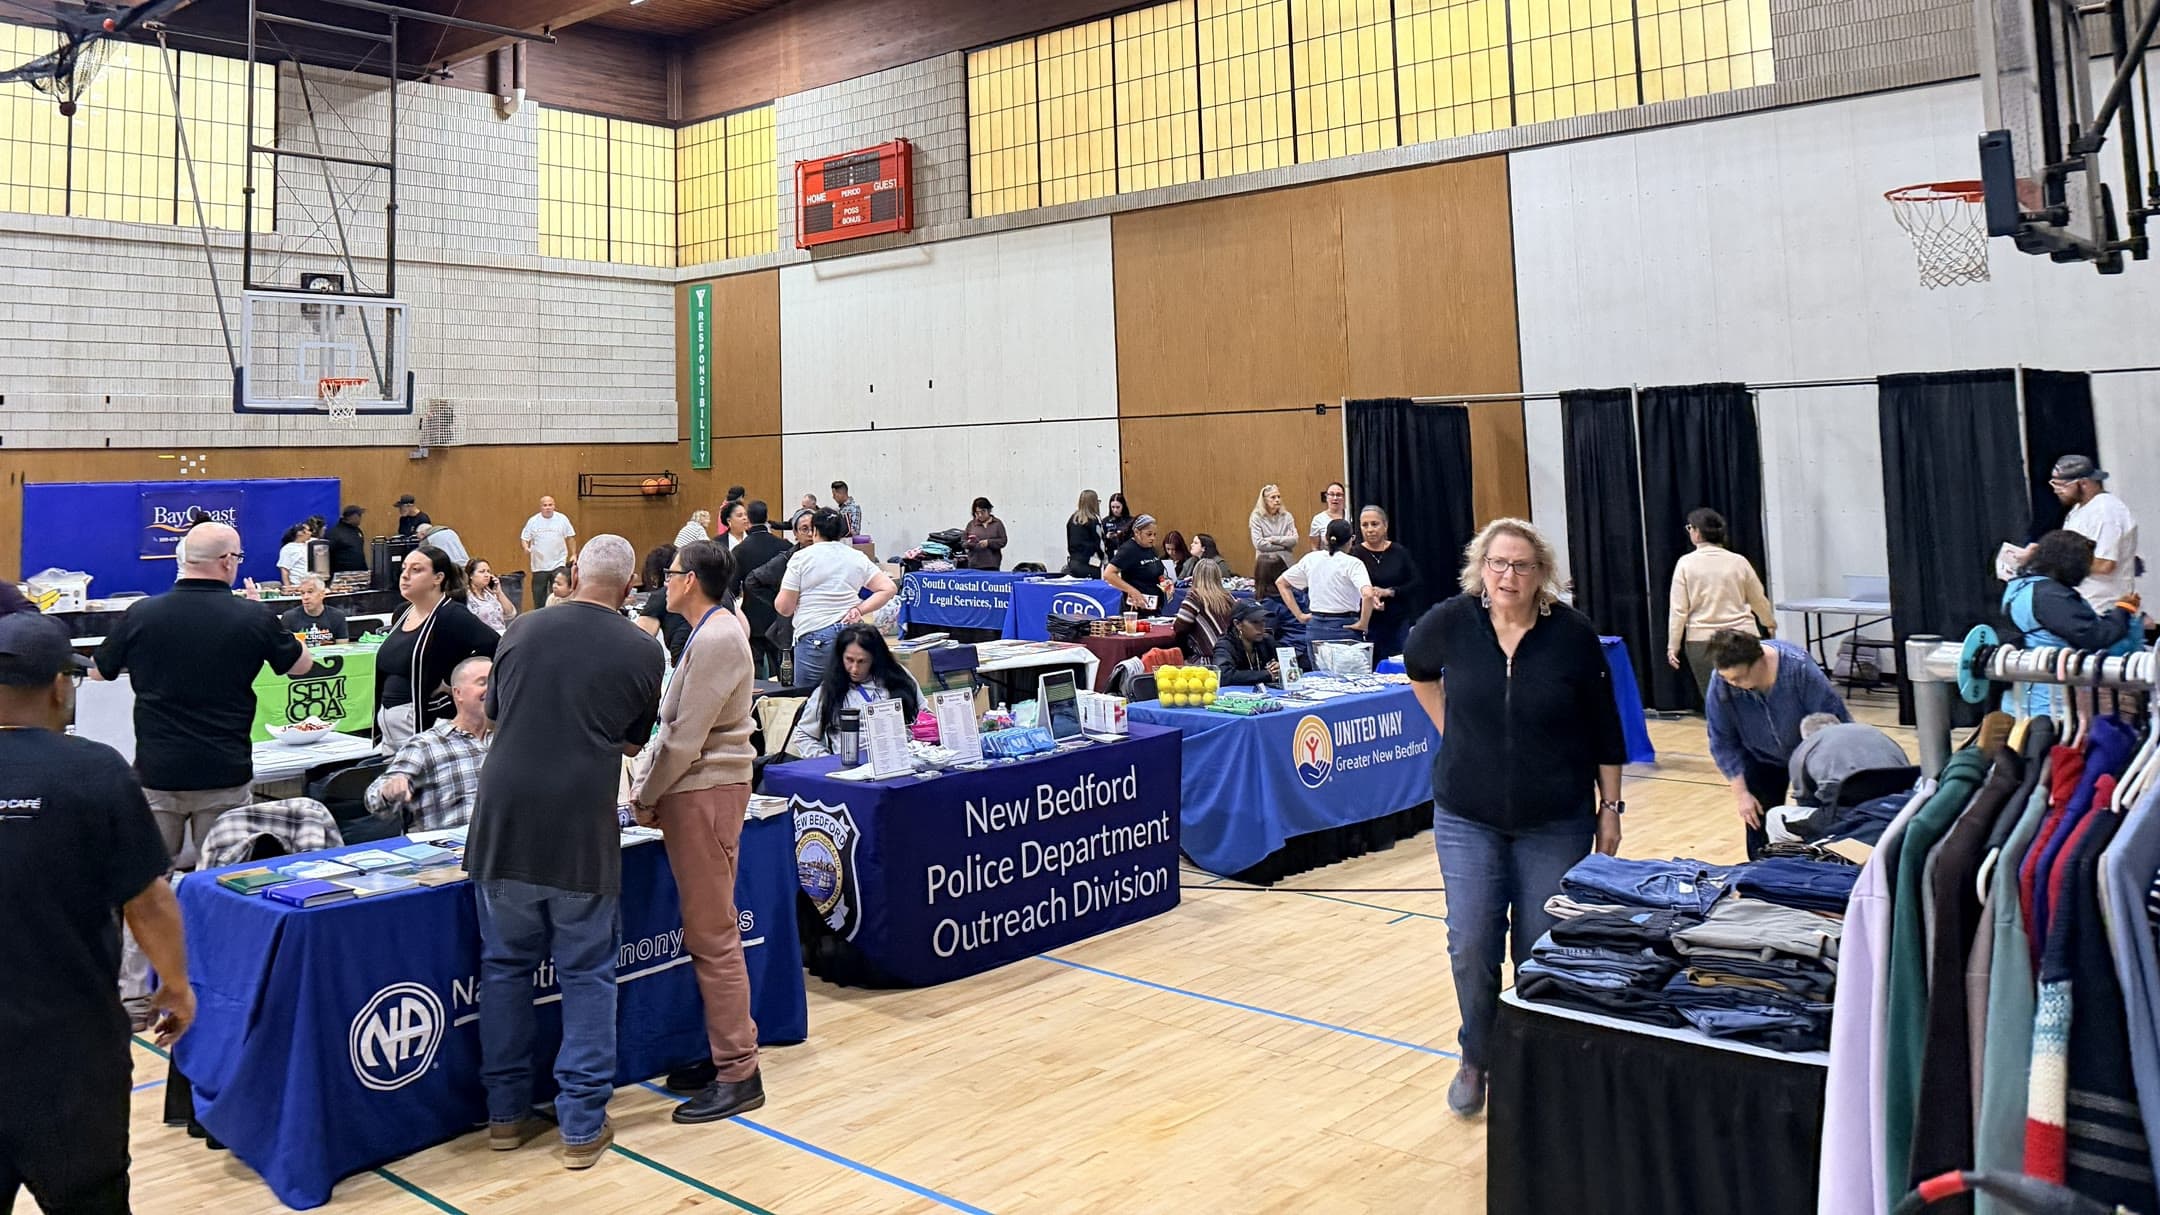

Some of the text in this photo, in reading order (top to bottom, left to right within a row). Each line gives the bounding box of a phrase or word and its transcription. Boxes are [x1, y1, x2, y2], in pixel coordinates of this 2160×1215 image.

[841, 188, 861, 198] PERIOD
[874, 179, 897, 191] GUEST
[806, 192, 827, 204] HOME
[842, 215, 861, 225] BONUS
[843, 206, 860, 215] POSS
[698, 311, 706, 463] RESPONSIBILITY
[153, 505, 237, 528] BayCast
[922, 577, 1013, 593] South Coastal Counti
[929, 593, 953, 608] Legal
[954, 595, 992, 609] Services,
[291, 678, 344, 702] SEM
[289, 698, 345, 721] COA
[1334, 710, 1402, 746] UNITED WAY
[1336, 737, 1428, 772] Greater New Bedford
[965, 764, 1137, 838] New Bedford
[796, 814, 846, 847] EW BEDFORD
[927, 810, 1170, 905] Police Department
[932, 864, 1168, 958] Outreach Division
[360, 997, 434, 1074] NA
